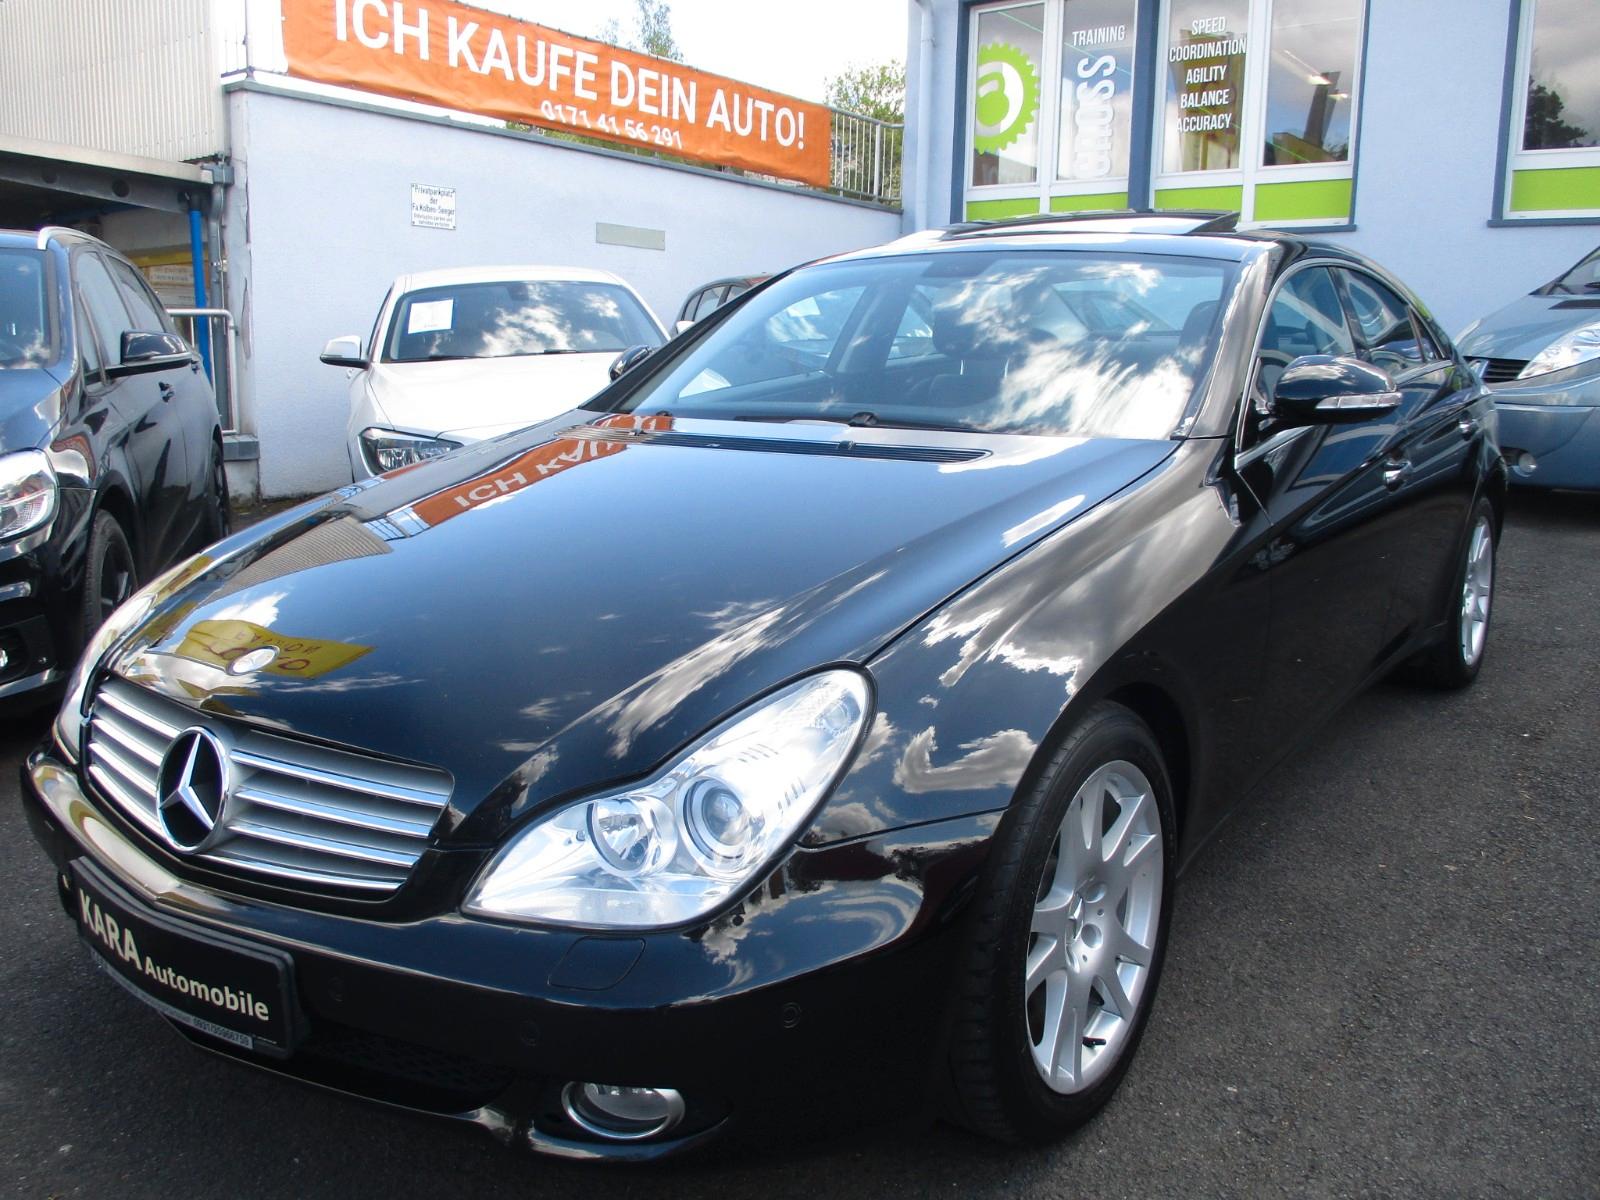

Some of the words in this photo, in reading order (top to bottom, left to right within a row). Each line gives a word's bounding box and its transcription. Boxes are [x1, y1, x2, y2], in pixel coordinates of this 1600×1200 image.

[1072, 25, 1125, 46] TRAINING
[1192, 16, 1226, 35] SPEED
[1169, 38, 1247, 62] COORDINATION
[334, 0, 430, 61] ICH
[448, 16, 598, 101] KAUFE
[610, 60, 697, 124] DEIN
[706, 88, 805, 150] AUTO!
[1185, 65, 1227, 84] AGILITY
[1180, 88, 1230, 109] BALANCE
[541, 100, 592, 129] 0171
[597, 113, 620, 135] 41
[625, 119, 649, 142] 56
[651, 125, 682, 149] 291
[1176, 113, 1232, 133] ACCURACY
[79, 888, 143, 971] KARA
[145, 956, 270, 1021] Automobile
